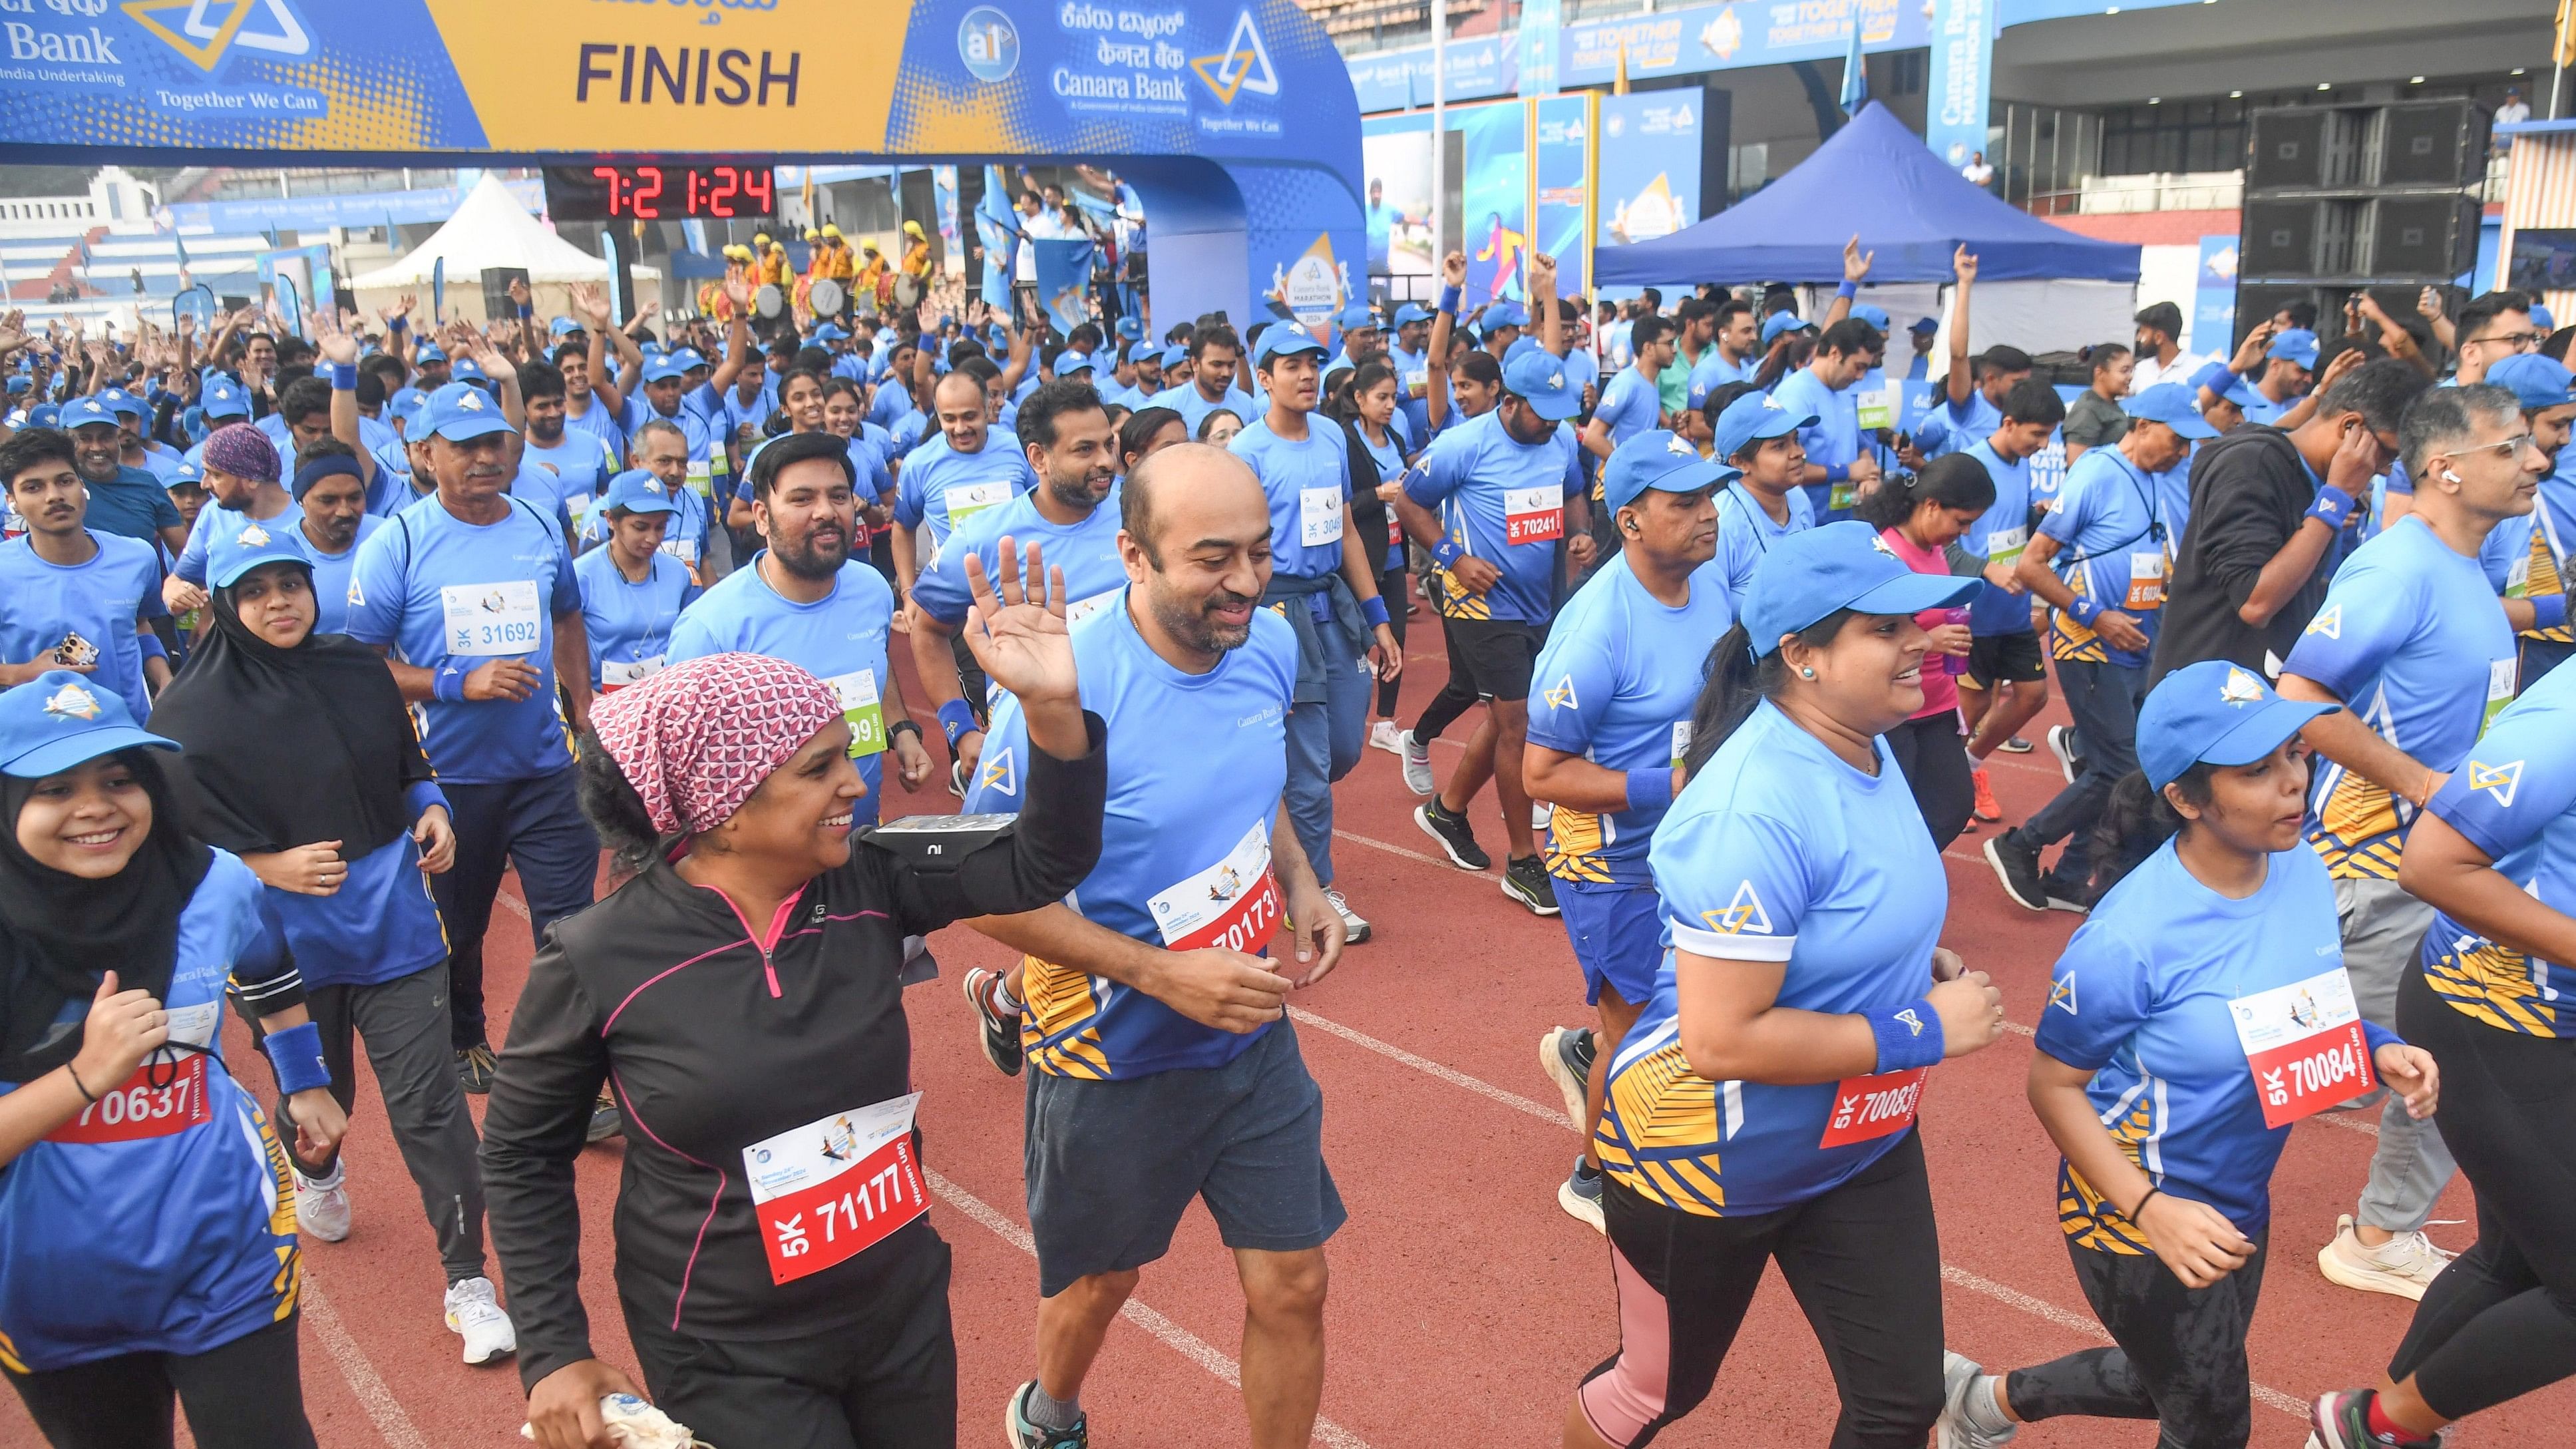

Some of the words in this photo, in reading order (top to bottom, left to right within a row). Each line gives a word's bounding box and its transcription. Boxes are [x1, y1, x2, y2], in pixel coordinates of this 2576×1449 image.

[3, 21, 121, 64] Bank
[38, 69, 126, 87] Undertaking
[576, 43, 801, 106] FINISH
[1053, 67, 1129, 99] Canara
[1135, 72, 1187, 101] Bank
[156, 90, 246, 112] Together
[248, 92, 279, 109] We
[283, 92, 319, 110] Can
[1201, 116, 1243, 133] Together
[1245, 119, 1260, 132] We
[1261, 120, 1280, 133] Can
[1308, 522, 1317, 538] 3K
[1510, 521, 1520, 538] 5K
[1522, 516, 1555, 536] 70241
[457, 629, 471, 648] 3K
[482, 622, 536, 644] 31692
[1238, 714, 1262, 727] Canara
[2288, 1043, 2356, 1097] 70084
[2355, 1048, 2369, 1088] Women
[1857, 1082, 1917, 1124] 70083
[2262, 1066, 2289, 1106] 5K
[1833, 1094, 1860, 1129] 5K
[816, 1162, 903, 1243] 71177
[904, 1165, 923, 1206] Women
[774, 1212, 810, 1257] 5K
